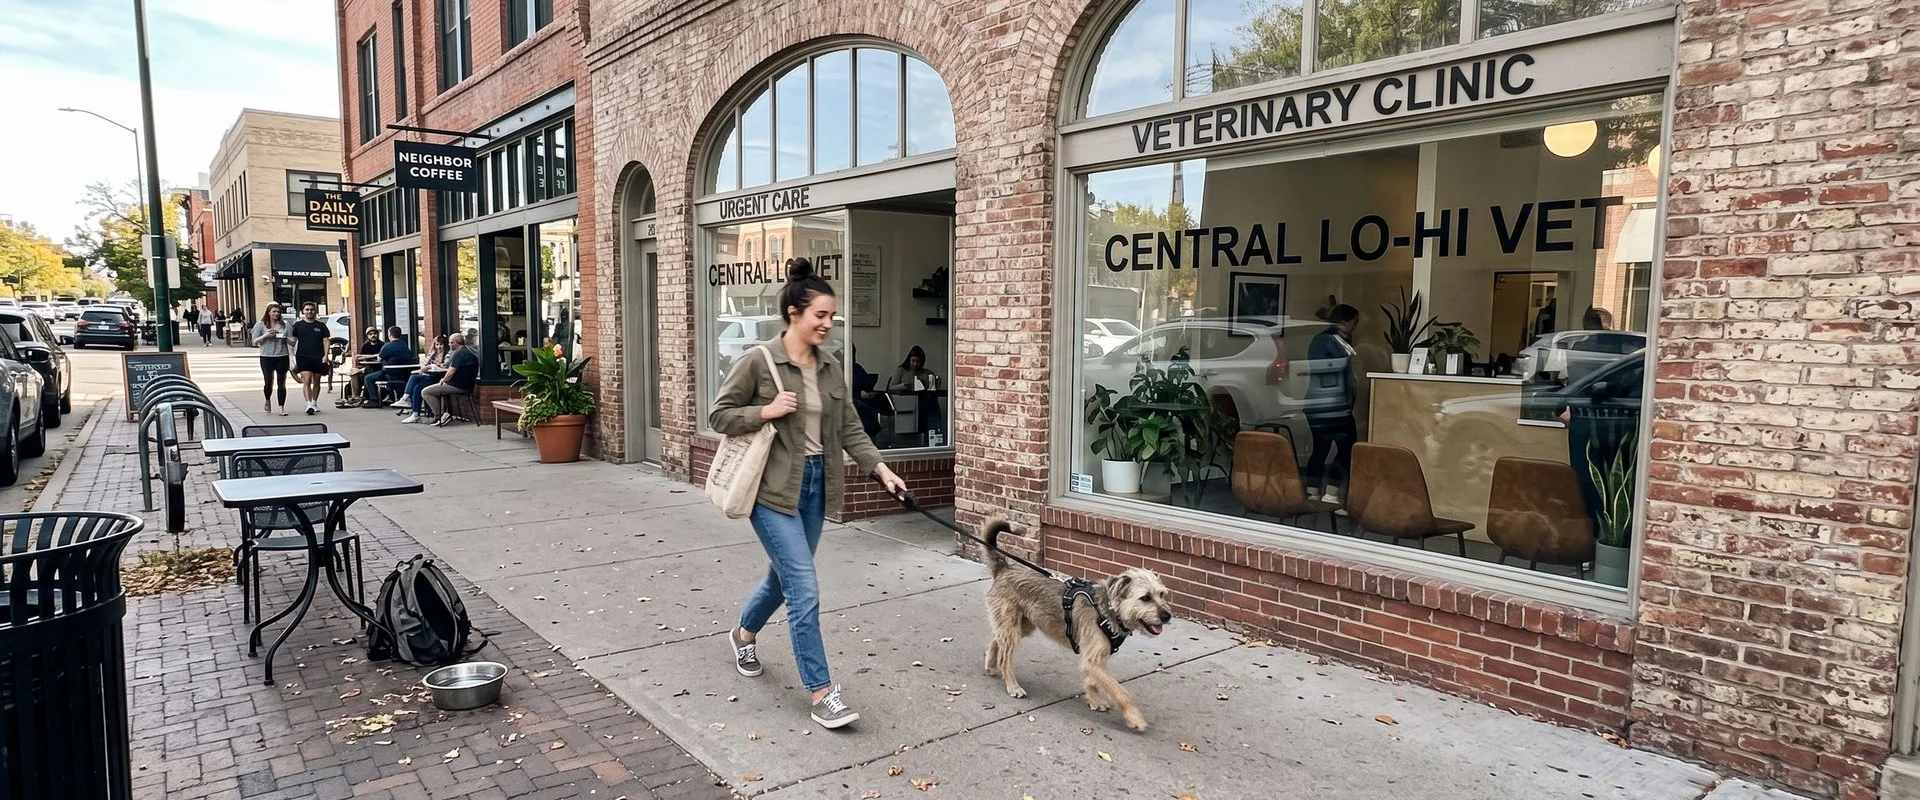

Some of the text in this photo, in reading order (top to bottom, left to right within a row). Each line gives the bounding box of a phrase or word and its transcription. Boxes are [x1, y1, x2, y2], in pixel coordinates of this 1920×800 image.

[1132, 53, 1535, 154] VETERINARY CLINIC
[399, 151, 472, 169] NEIGHBOR
[409, 166, 463, 181] COFFEE
[324, 192, 342, 200] THE
[719, 187, 810, 220] URGENT CARE
[309, 200, 356, 214] DAILY
[309, 212, 359, 226] GRIND
[1104, 195, 1624, 273] CENTRAL LO-HI VET
[708, 261, 772, 287] CENTRAL
[808, 254, 843, 281] VET
